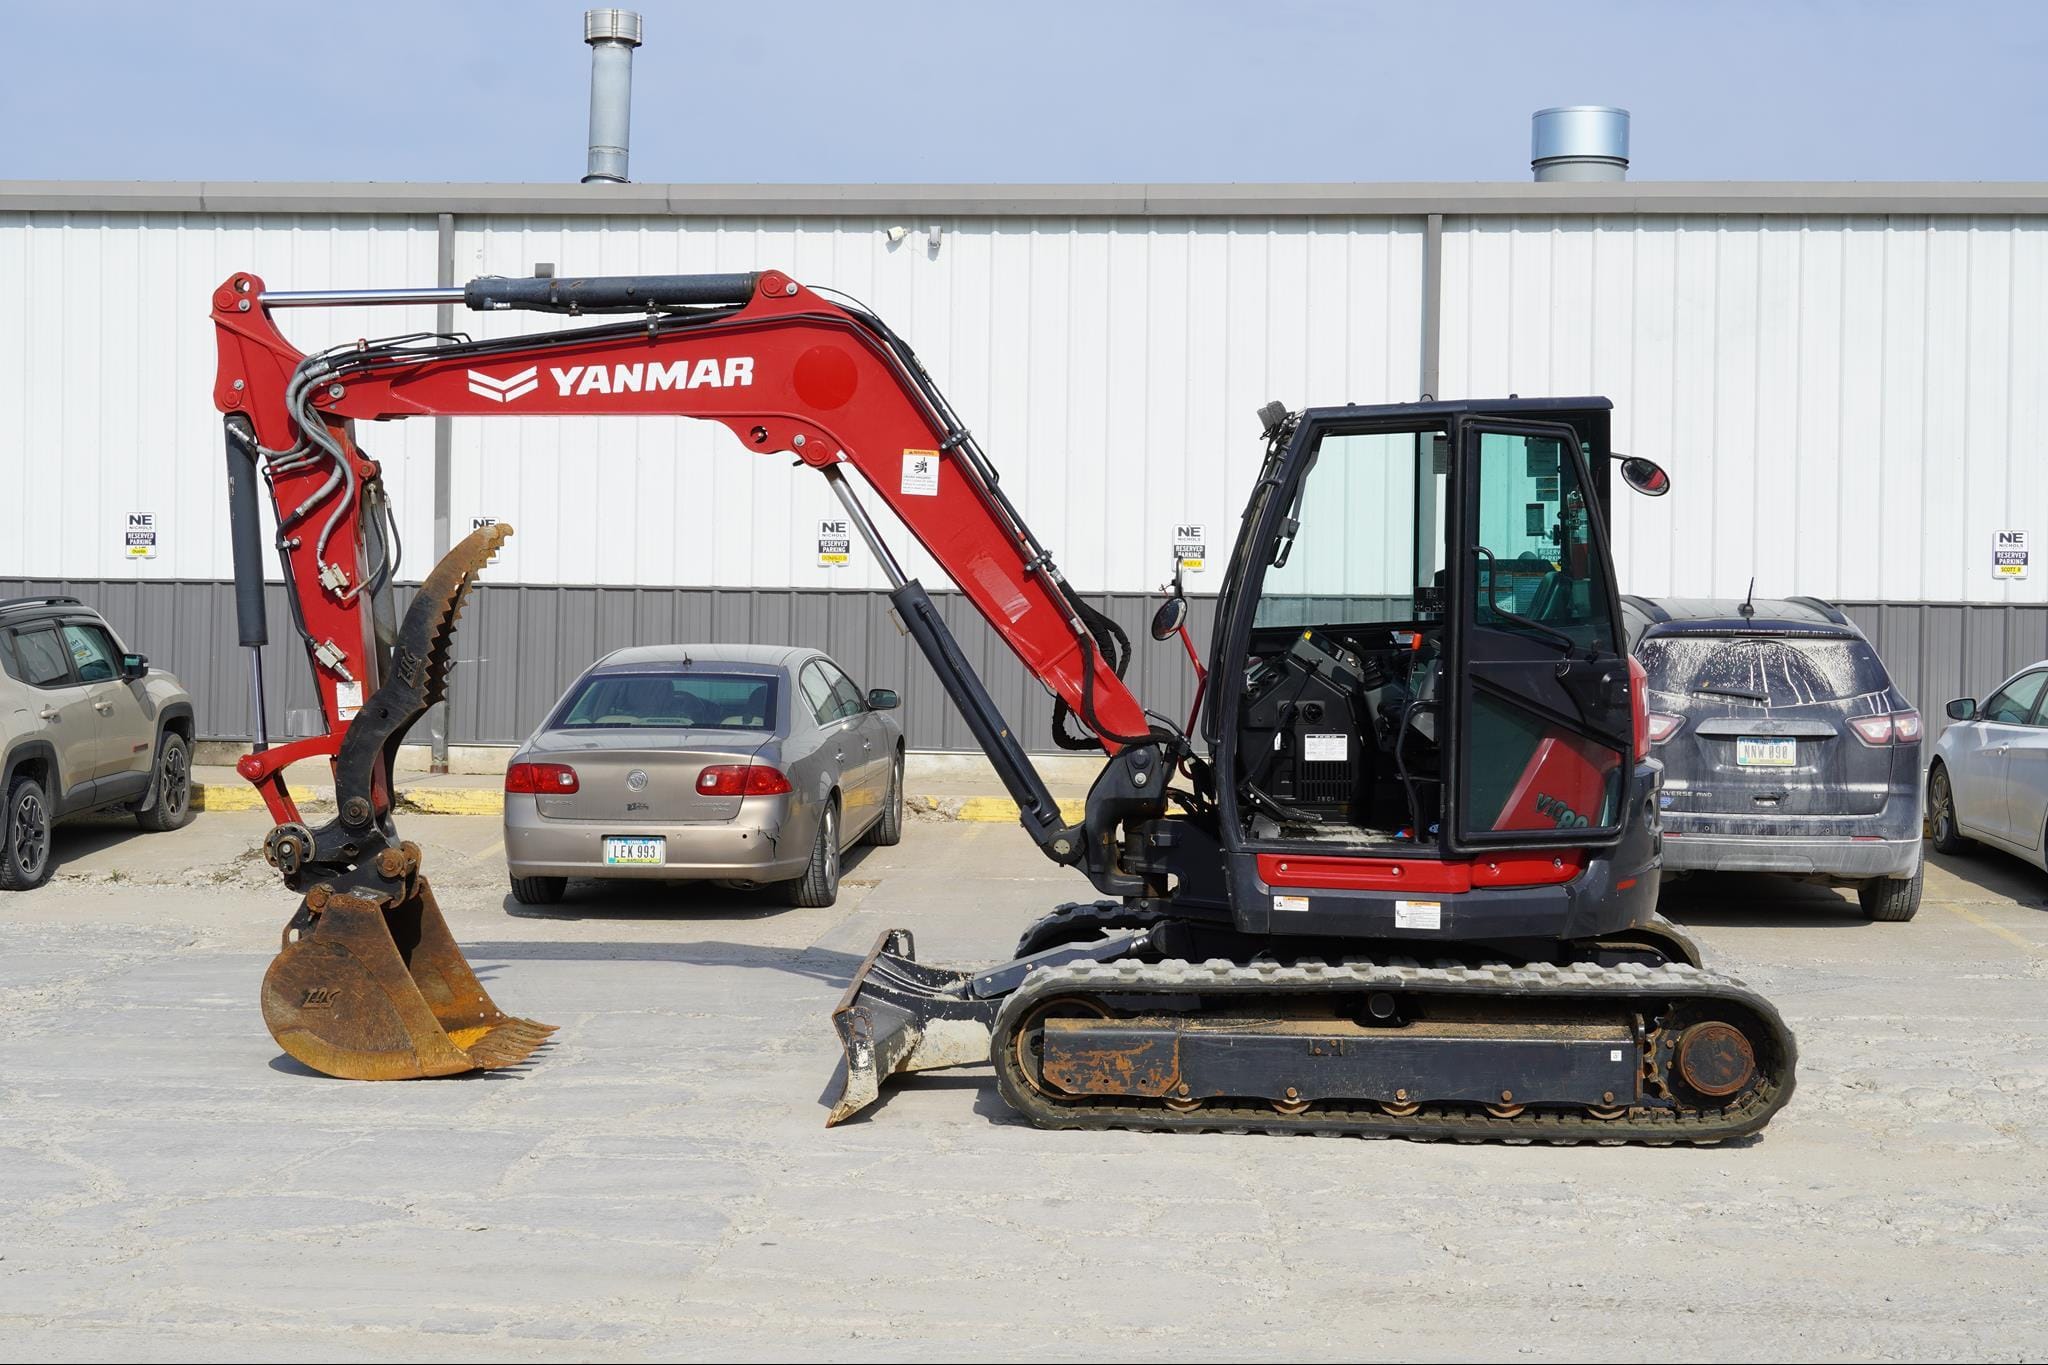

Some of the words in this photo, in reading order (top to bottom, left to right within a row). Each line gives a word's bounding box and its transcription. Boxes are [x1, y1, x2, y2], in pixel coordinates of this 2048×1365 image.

[550, 357, 754, 396] YANMAR
[129, 515, 152, 525] NE
[822, 522, 846, 532] NE
[1178, 527, 1201, 537] NE
[1999, 533, 2024, 543] NE
[1744, 745, 1765, 759] NNW
[613, 845, 634, 858] LEK
[637, 845, 656, 859] 993
